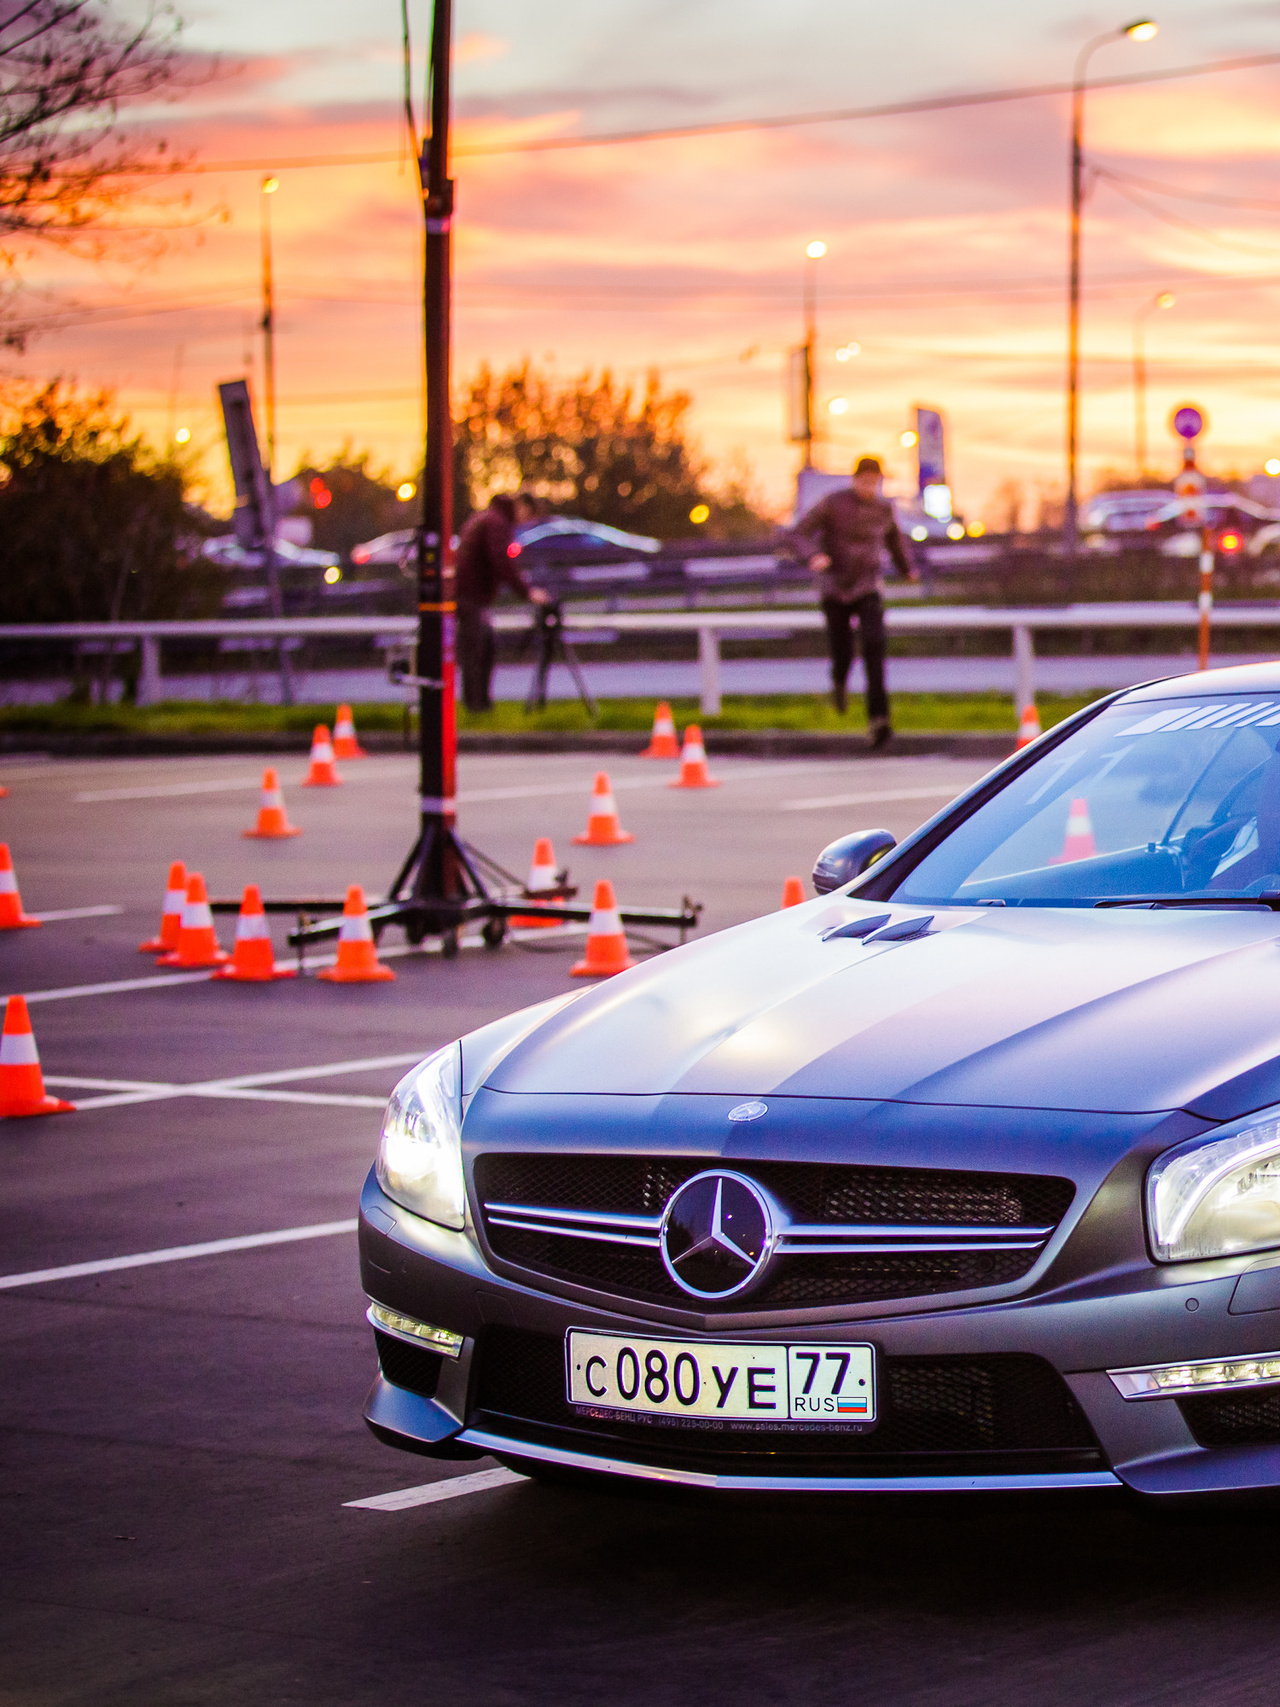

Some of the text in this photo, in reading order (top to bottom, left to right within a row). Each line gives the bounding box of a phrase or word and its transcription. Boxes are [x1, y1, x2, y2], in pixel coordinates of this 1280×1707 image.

[796, 1352, 851, 1395] 77
[795, 1396, 835, 1412] RUS
[637, 1414, 653, 1424] РУС
[658, 1417, 680, 1427] (495)
[681, 1418, 724, 1430] 225-00-00
[730, 1421, 863, 1432] www.sales.mercedes-benz.ru
